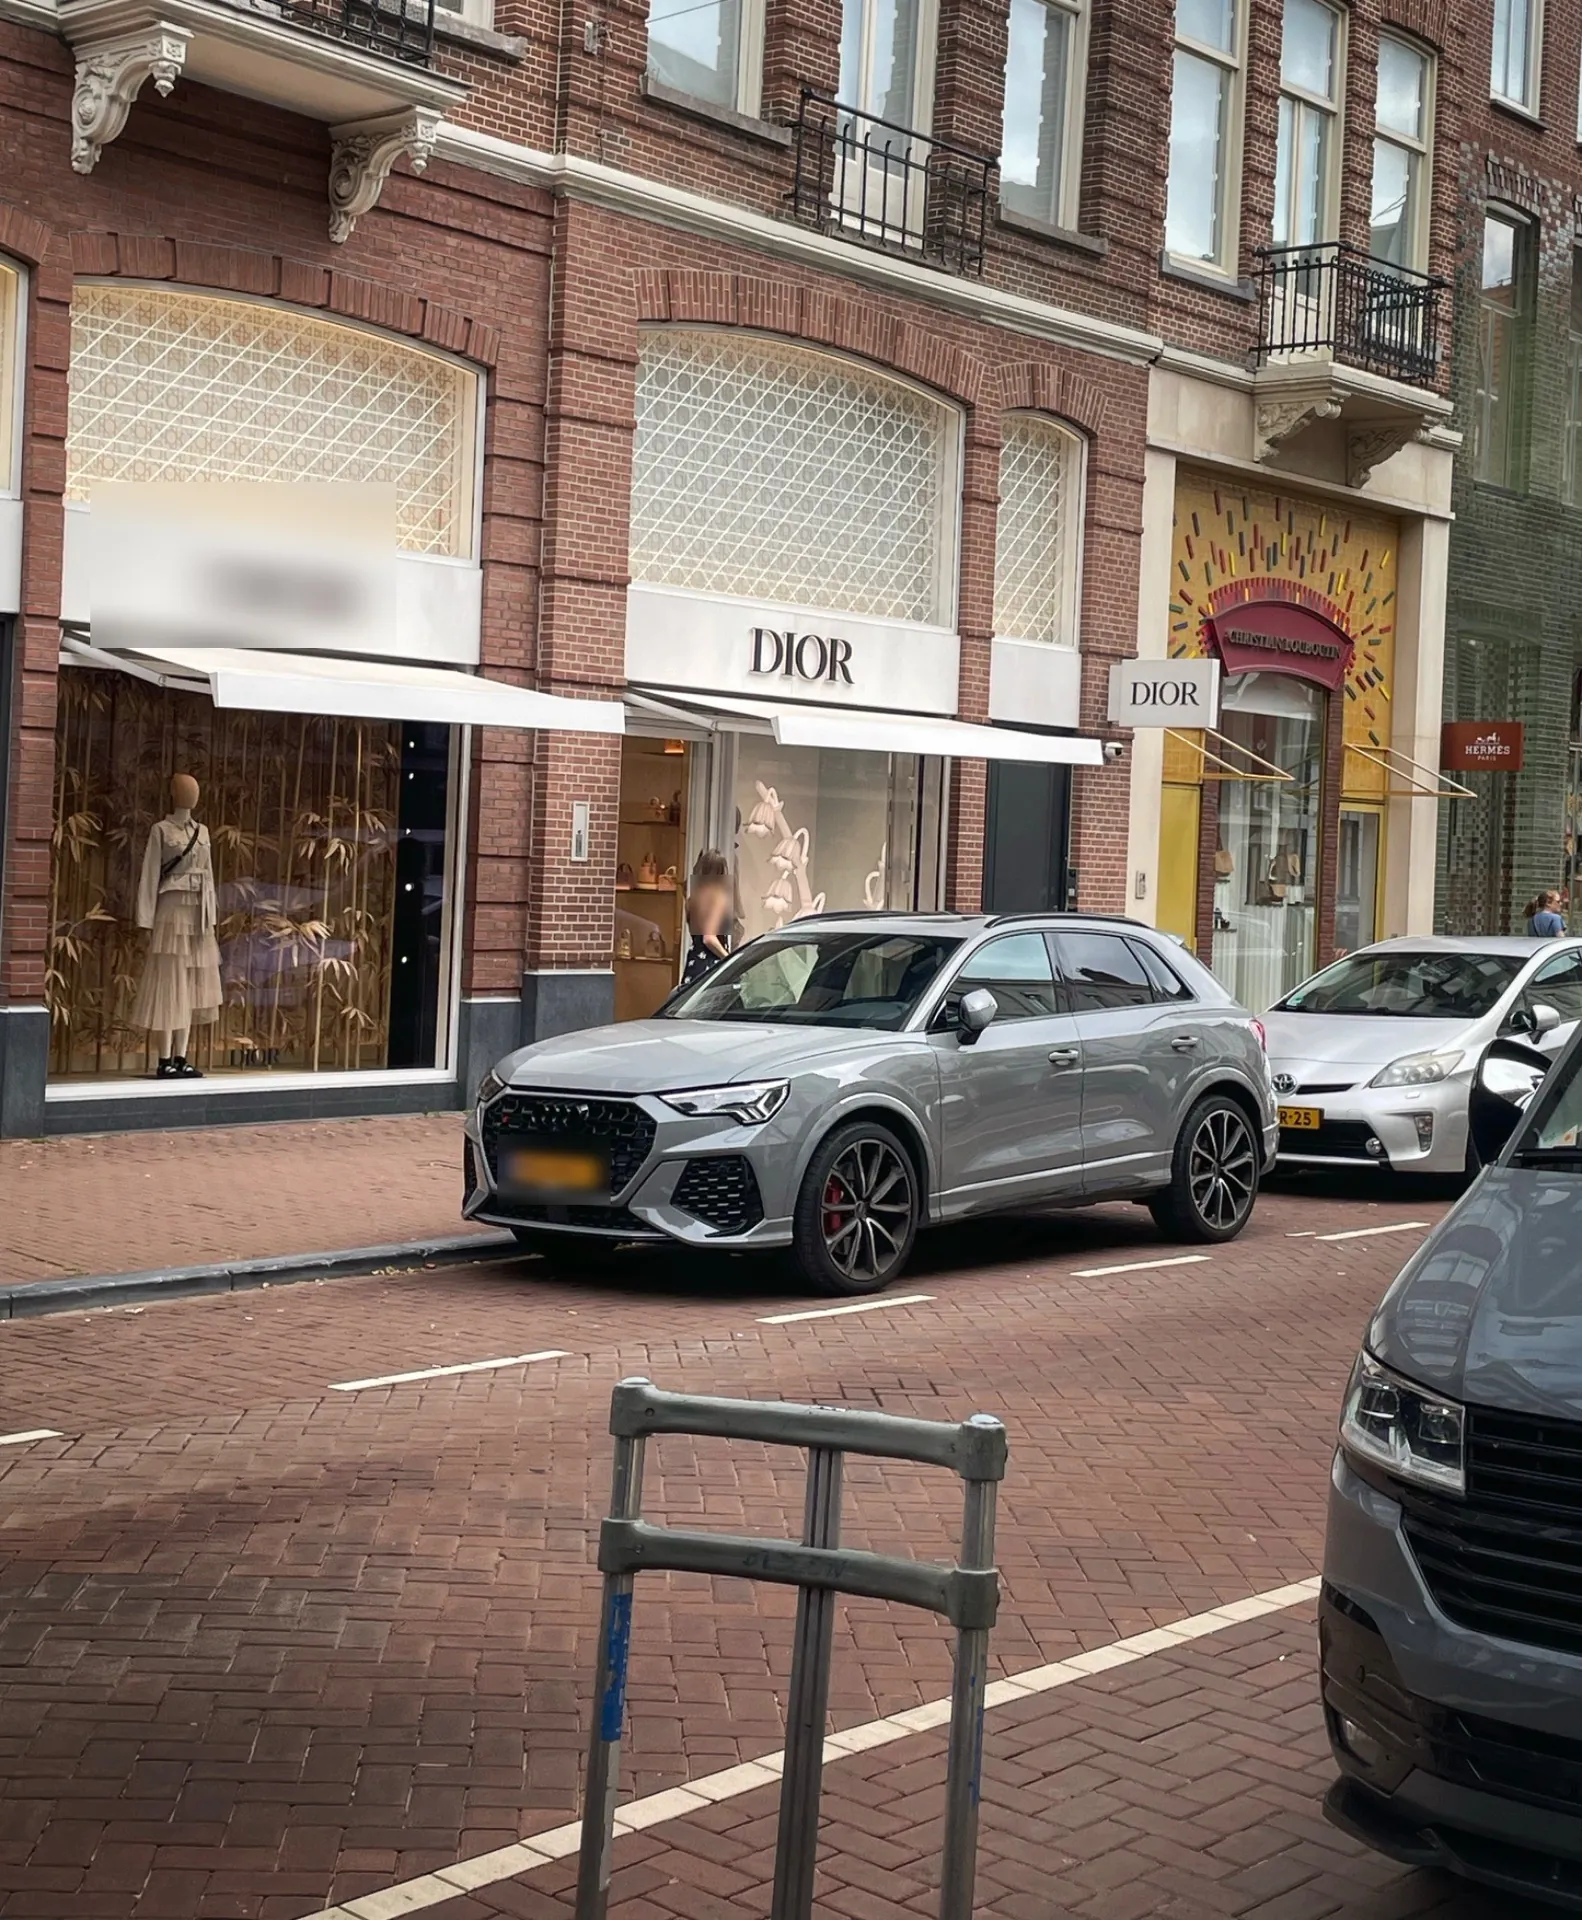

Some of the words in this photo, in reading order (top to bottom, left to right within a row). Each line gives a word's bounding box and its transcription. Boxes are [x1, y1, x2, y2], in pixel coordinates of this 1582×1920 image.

[750, 627, 855, 685] DIOR
[1228, 628, 1285, 650] CHRISTIAN
[1285, 639, 1340, 659] LOUBOUTIN
[1130, 681, 1200, 706] DIOR
